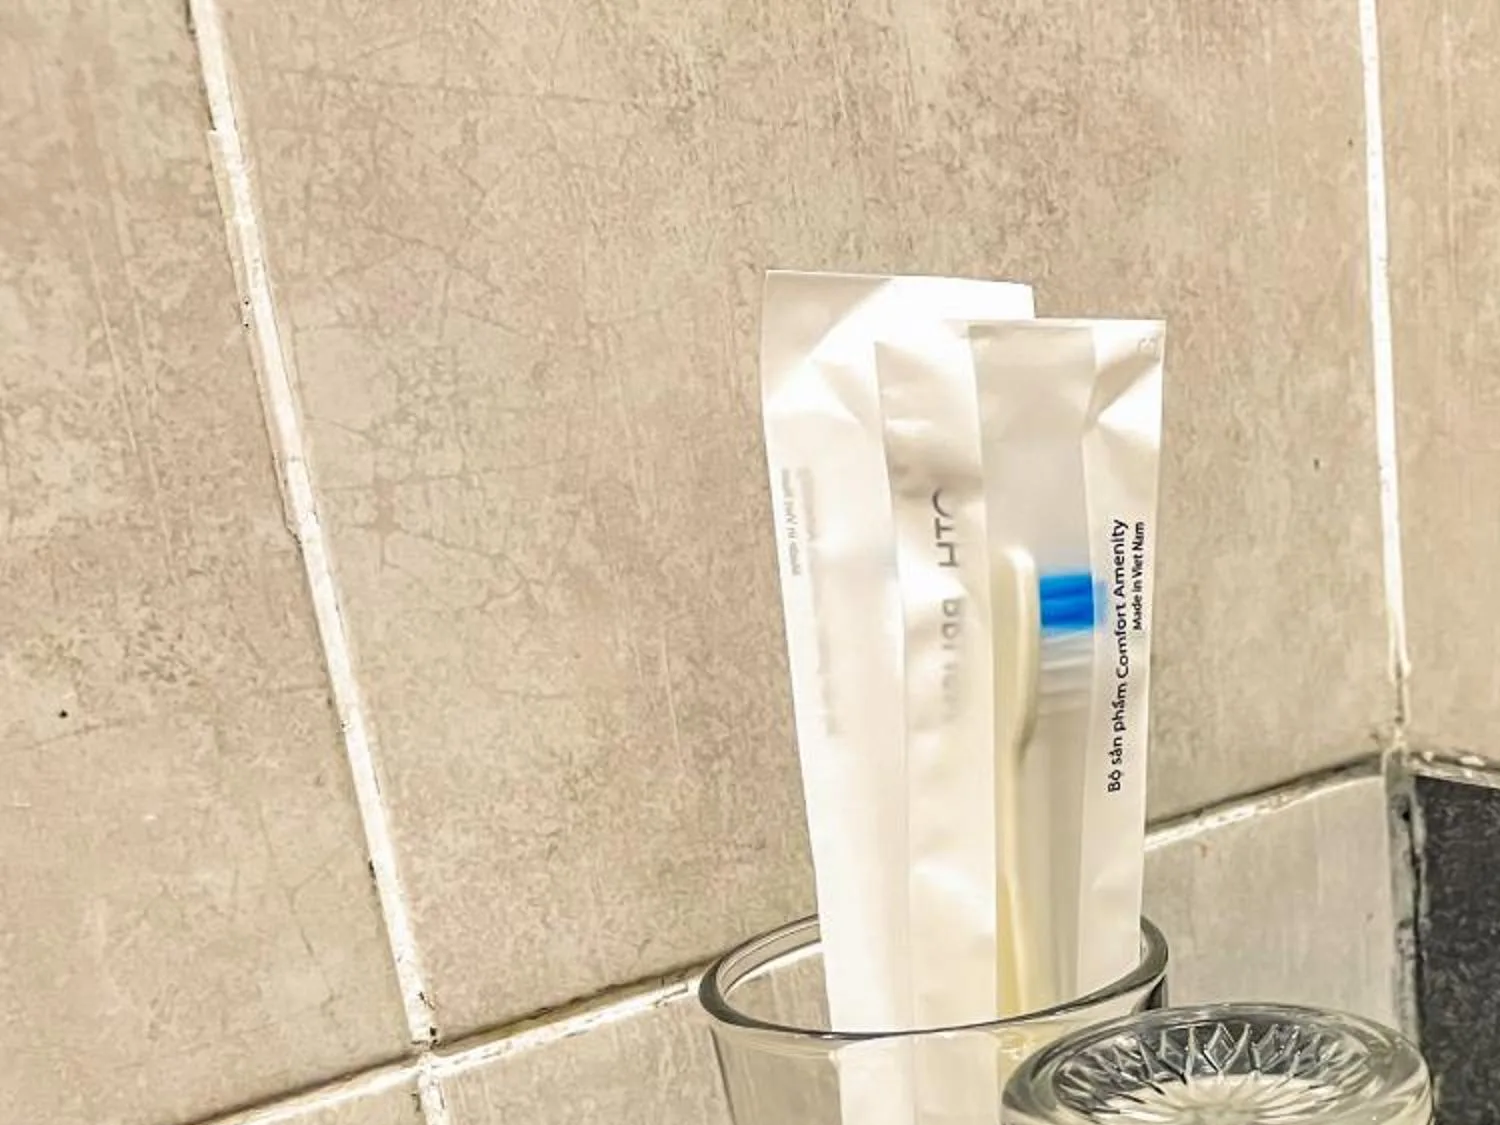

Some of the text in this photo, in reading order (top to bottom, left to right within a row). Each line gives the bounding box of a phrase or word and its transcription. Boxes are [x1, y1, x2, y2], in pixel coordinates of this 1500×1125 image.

[1113, 519, 1129, 597] Amenity
[1132, 521, 1145, 631] Made in Viet Nam
[1114, 602, 1129, 678] Comfort
